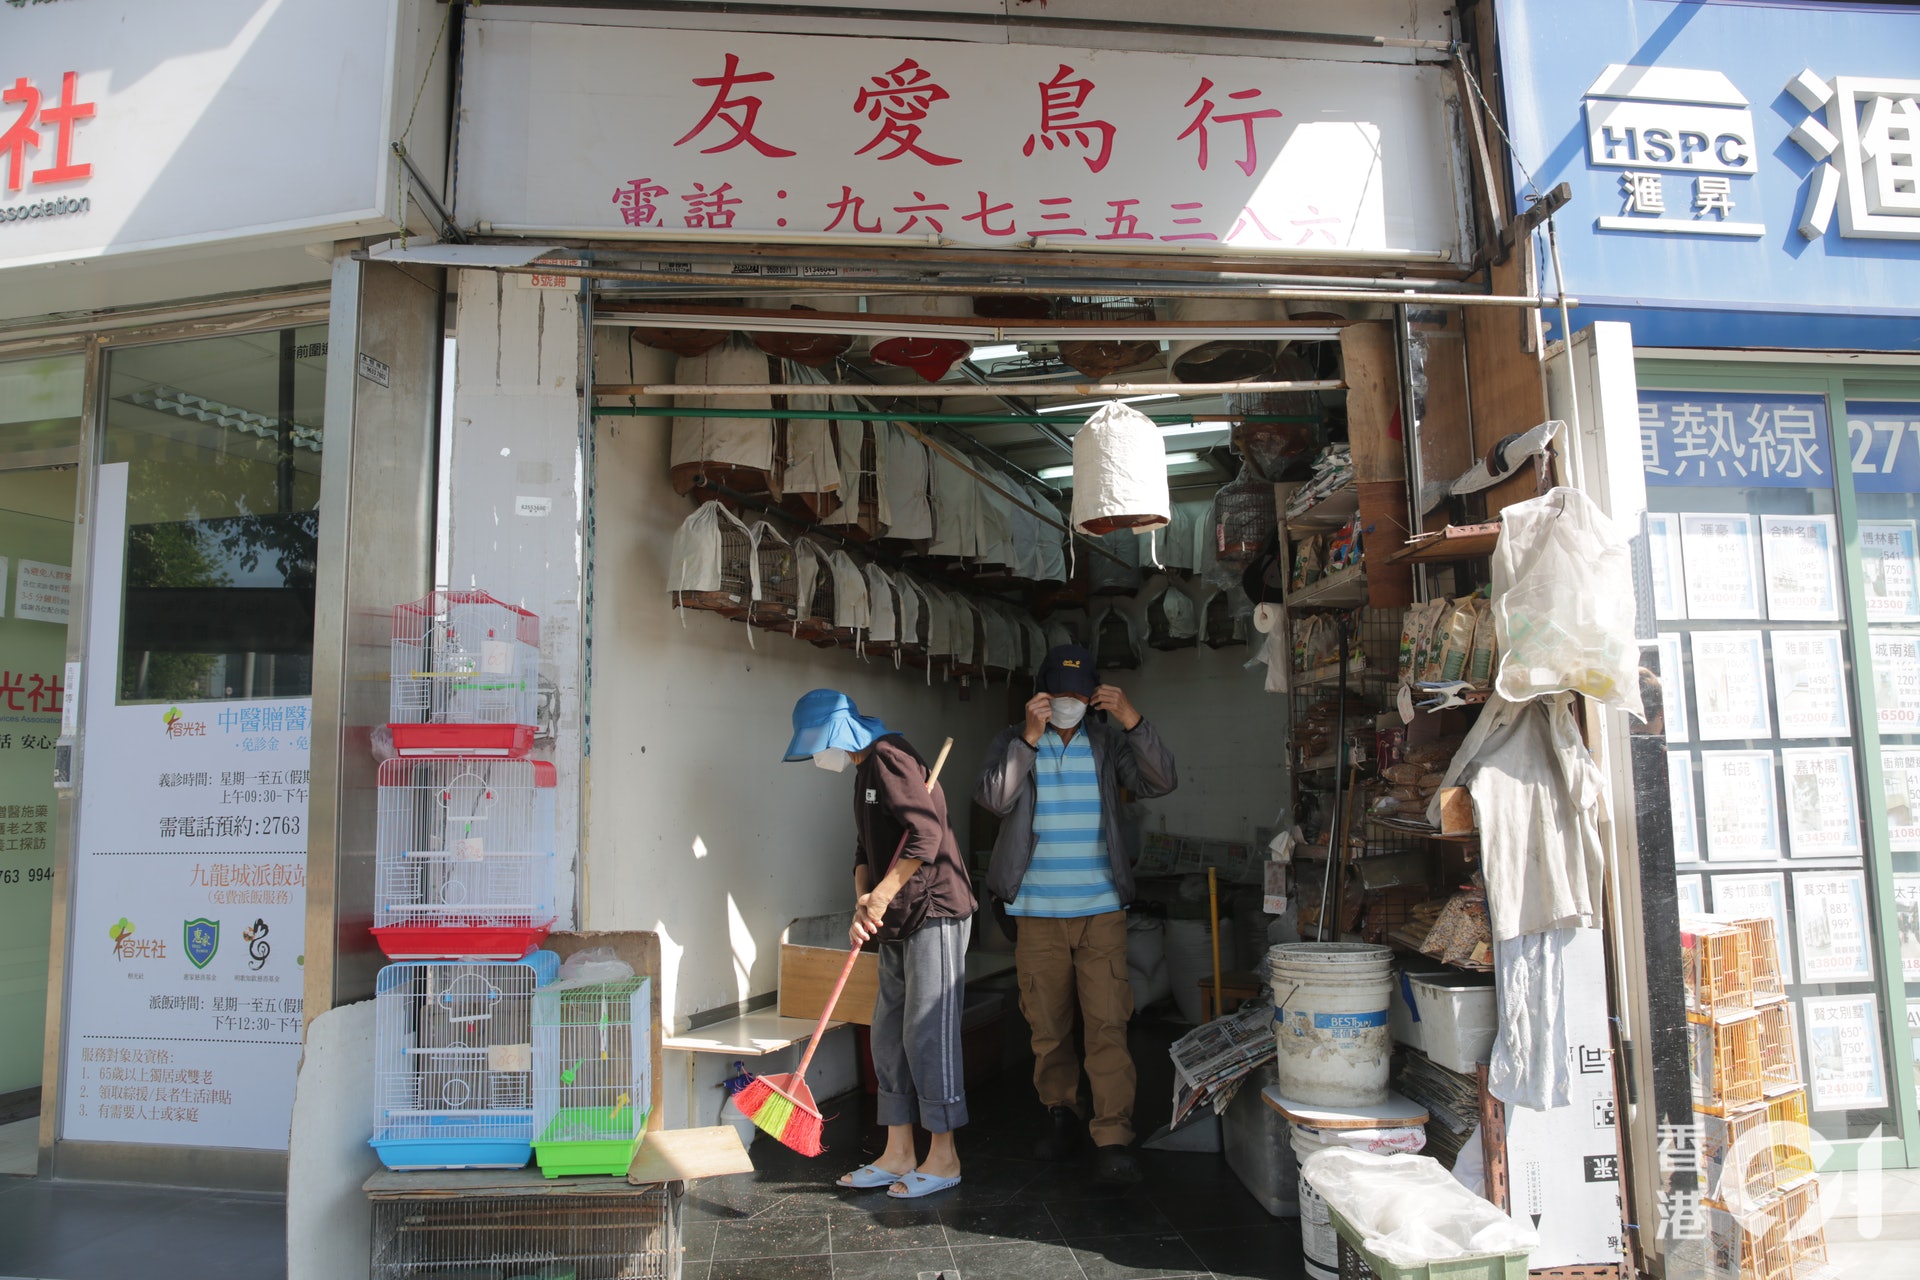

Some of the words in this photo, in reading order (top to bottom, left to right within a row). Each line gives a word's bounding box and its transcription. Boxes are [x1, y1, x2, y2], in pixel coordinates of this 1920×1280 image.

[0, 70, 97, 192] 社
[673, 52, 1283, 176] 友愛鳥行
[1601, 125, 1749, 168] HSPC
[823, 184, 1342, 247] 九六七三五三八六
[1622, 170, 1736, 219] 滙昇
[1875, 643, 1917, 657] 城南道
[218, 705, 312, 734] 中醫贈醫
